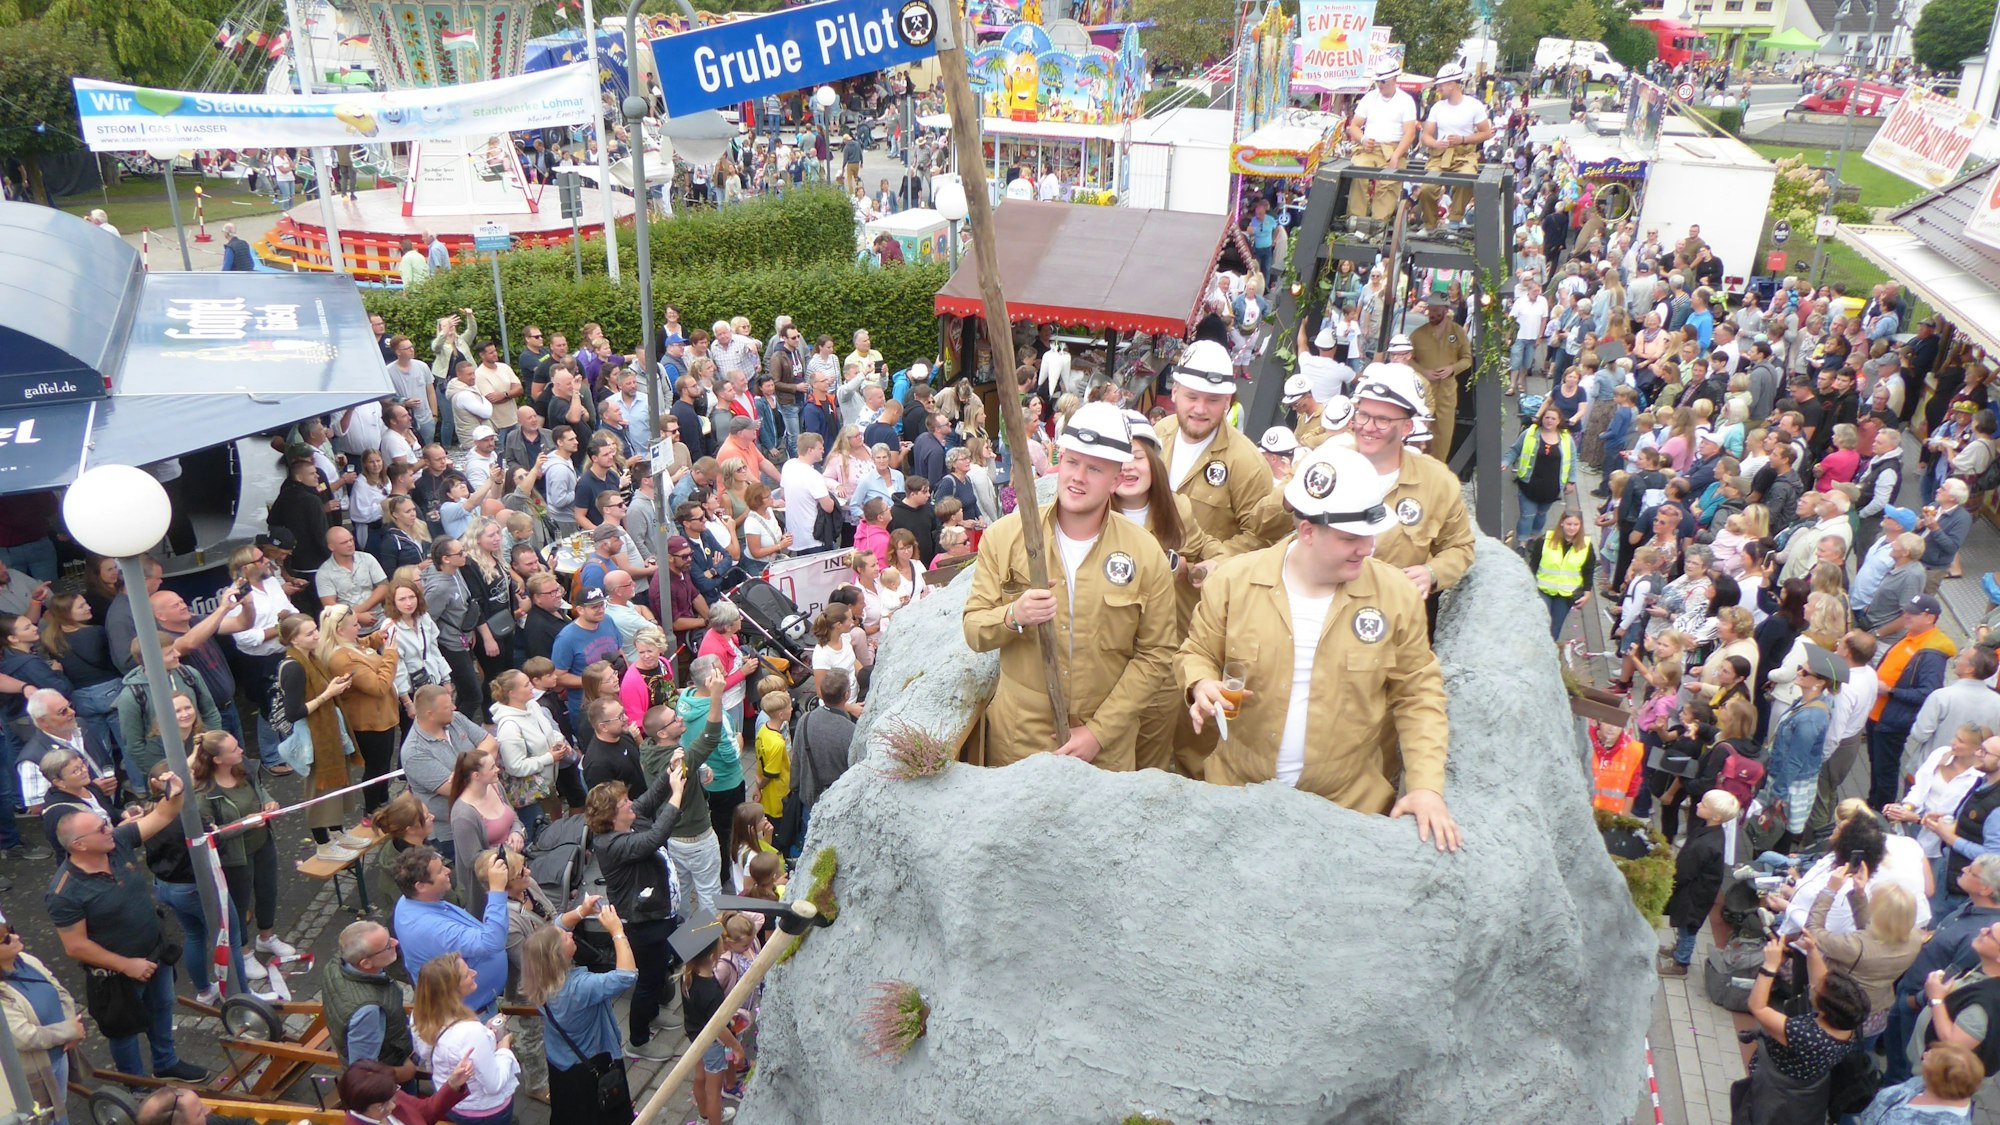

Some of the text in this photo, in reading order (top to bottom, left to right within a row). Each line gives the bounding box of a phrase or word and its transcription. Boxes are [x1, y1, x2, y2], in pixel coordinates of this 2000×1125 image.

[1307, 13, 1367, 33] ENTEN
[693, 8, 898, 94] Grube Pilot
[1305, 48, 1364, 68] ANGELN
[1323, 69, 1357, 79] ORIGINAL
[1680, 87, 1691, 96] 30
[88, 92, 132, 112] Wir
[542, 97, 584, 109] Lohmar
[96, 125, 227, 134] STROM GAS WASSER
[1883, 99, 1973, 170] Reibekuchen
[1583, 165, 1605, 176] Spiel
[24, 381, 77, 398] gaffel.de
